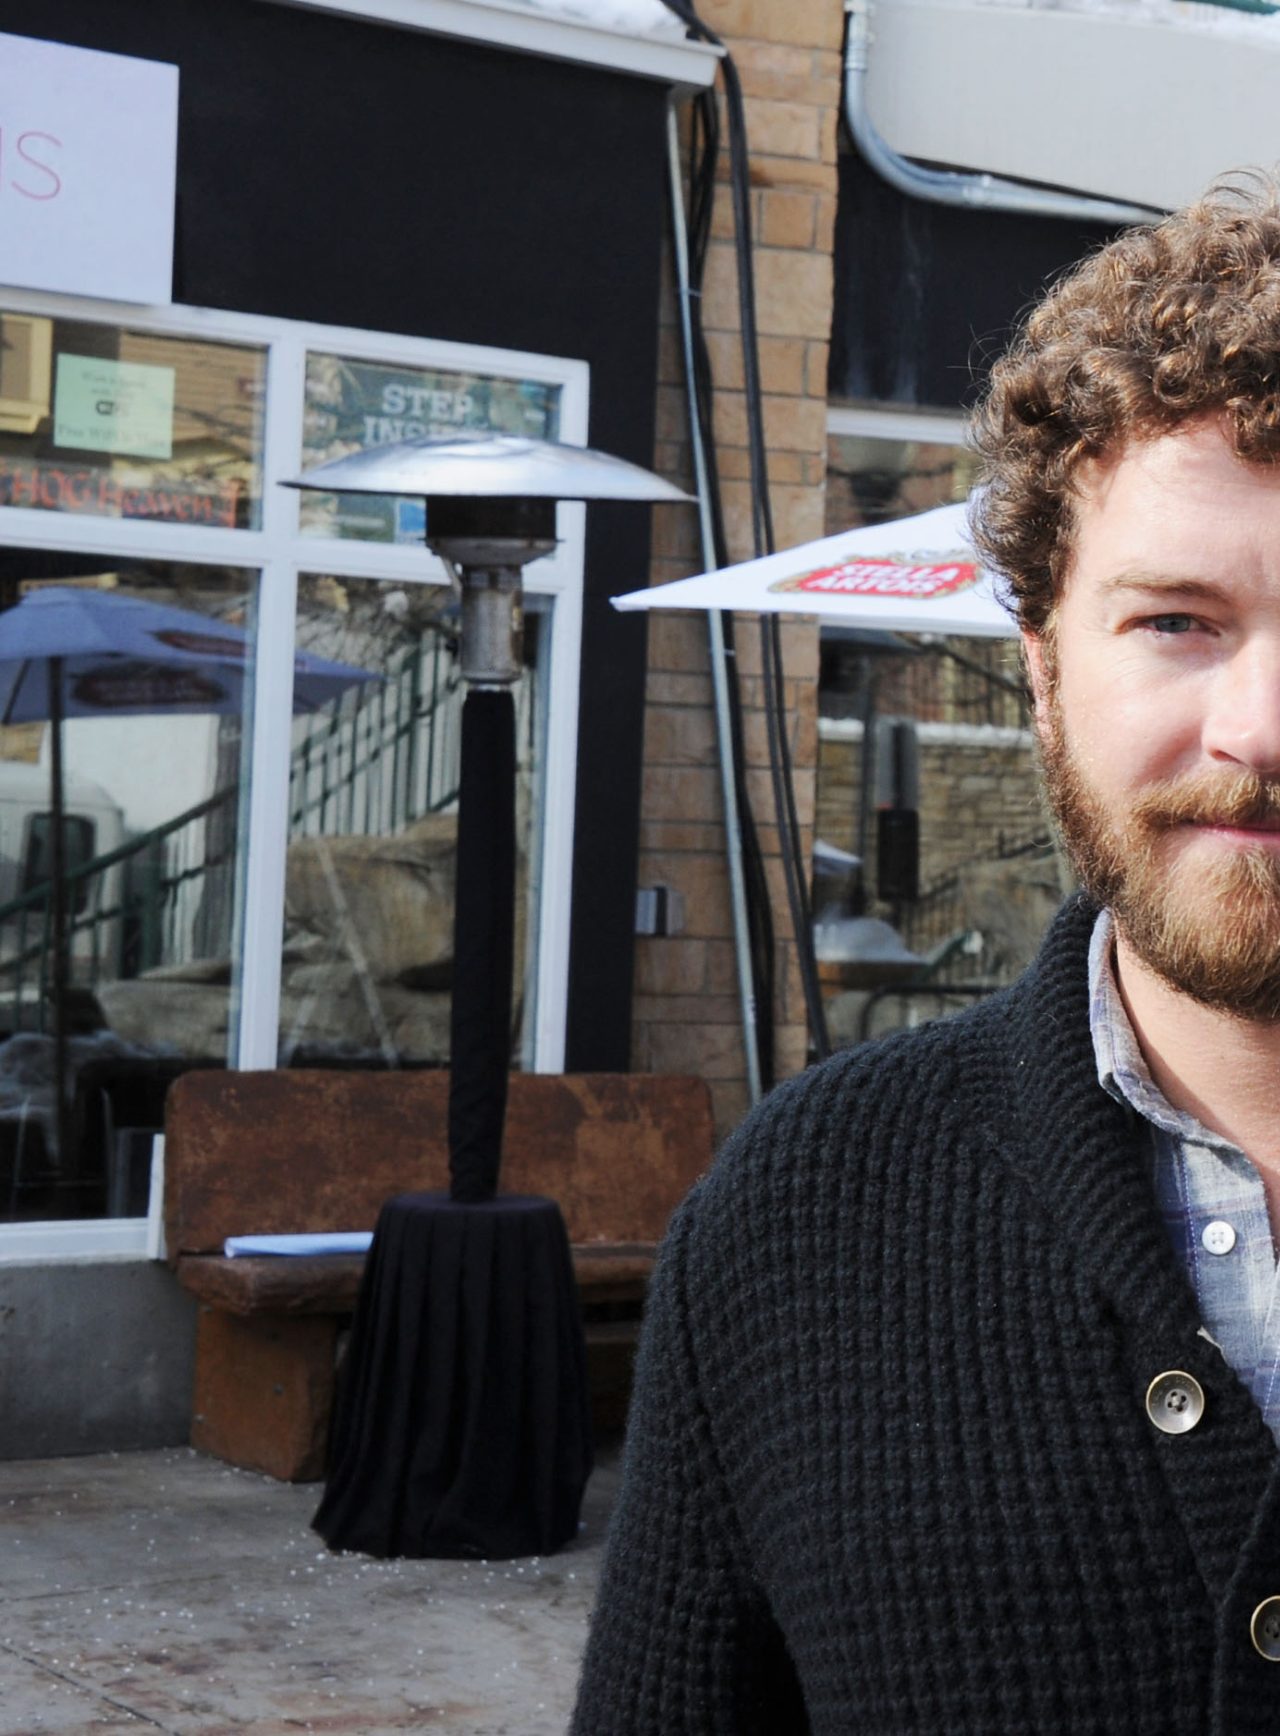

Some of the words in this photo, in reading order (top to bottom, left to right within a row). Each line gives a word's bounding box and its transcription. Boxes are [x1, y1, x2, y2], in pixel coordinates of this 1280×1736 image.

[382, 383, 474, 423] STEP
[12, 466, 93, 509] HOG
[805, 576, 945, 593] ARTOIS
[833, 563, 960, 581] STELLA
